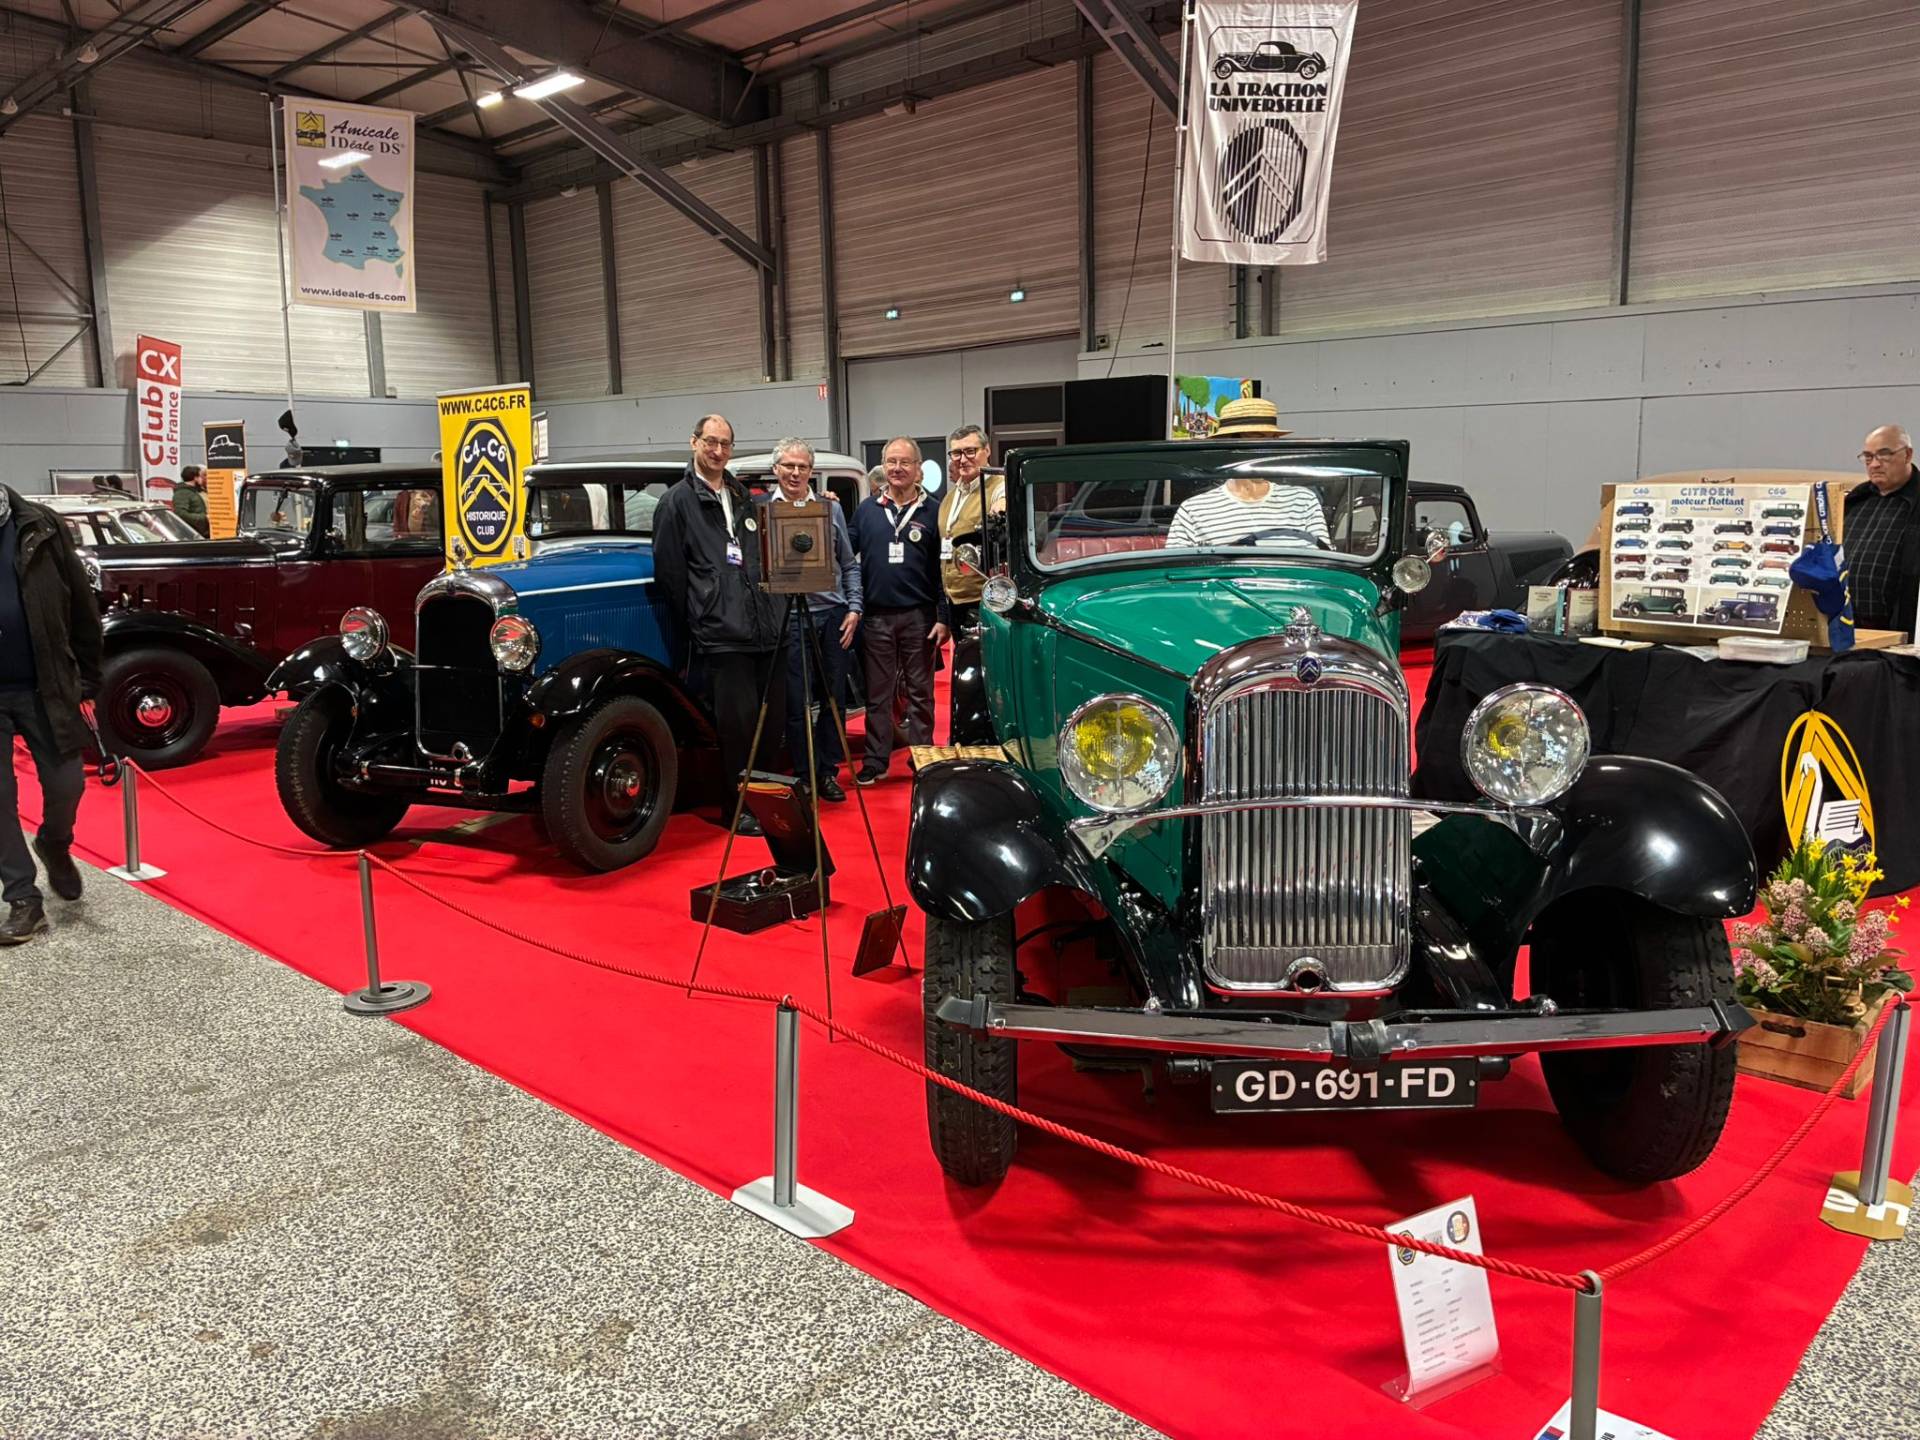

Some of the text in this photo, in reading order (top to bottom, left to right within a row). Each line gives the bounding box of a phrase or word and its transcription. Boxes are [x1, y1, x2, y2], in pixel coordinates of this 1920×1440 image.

[1210, 82, 1328, 98] LA TRACTION
[1209, 97, 1326, 113] UNIVERSELLE
[330, 119, 400, 140] Amicale
[300, 287, 407, 302] www.ideale-ds.com
[140, 349, 178, 380] CX
[441, 394, 526, 416] WWW.C4C6.FR
[140, 385, 164, 466] Club
[166, 391, 179, 466] de France
[462, 438, 507, 464] C4-C6
[1671, 497, 1706, 506] moteur
[1708, 496, 1745, 506] flottant
[466, 510, 507, 522] HISTORIQUE
[476, 525, 495, 536] CLUB
[1235, 1067, 1456, 1102] GD-691-FD
